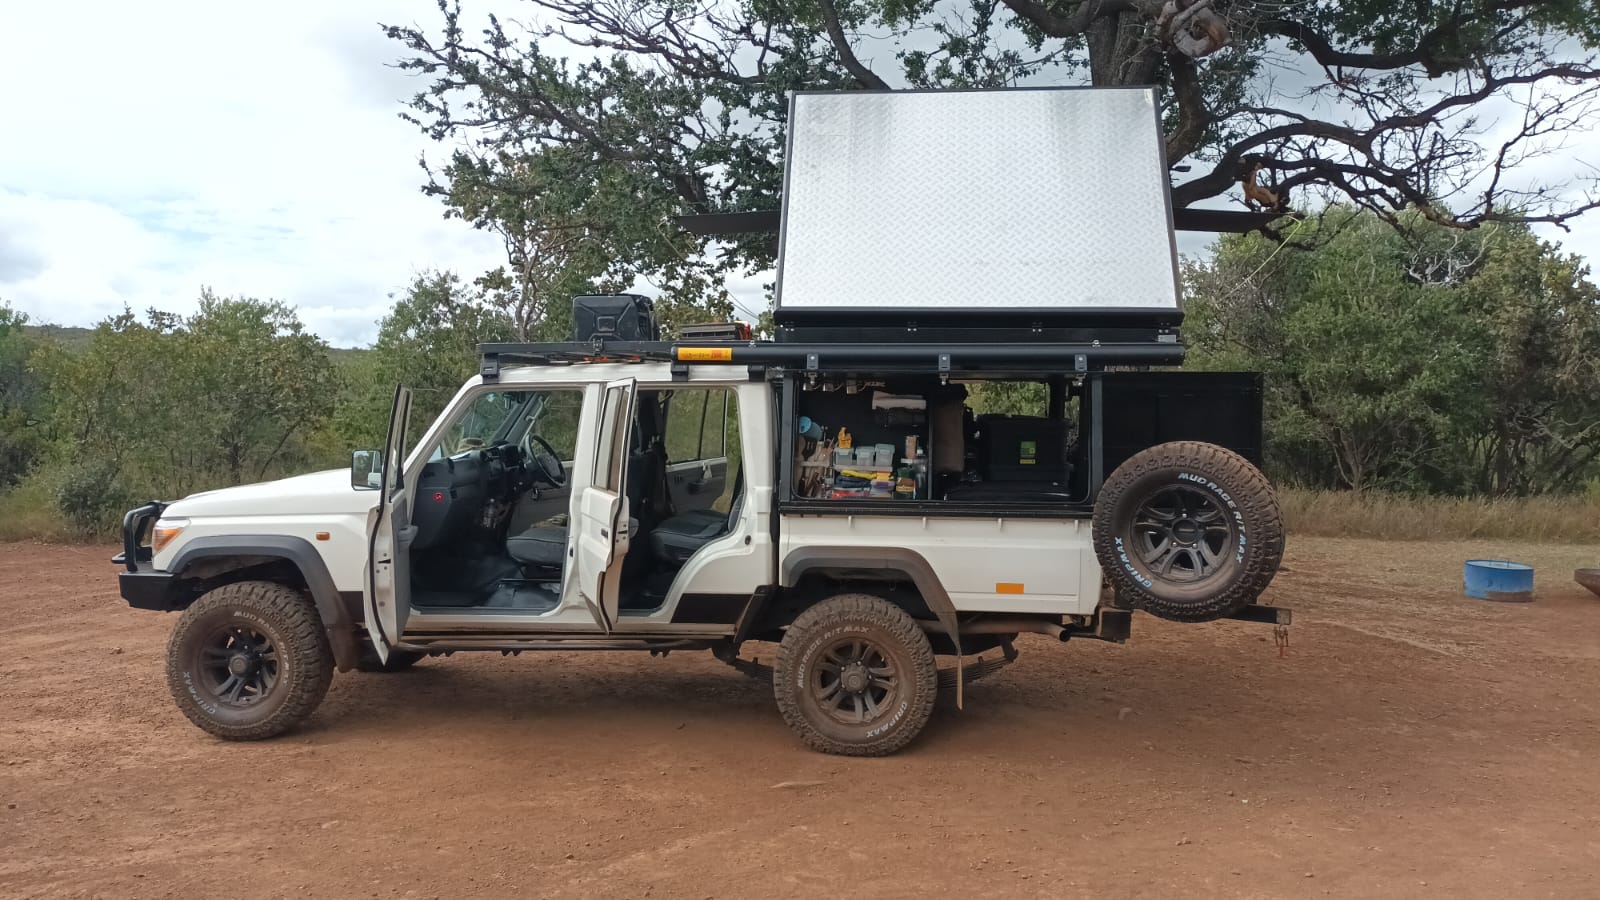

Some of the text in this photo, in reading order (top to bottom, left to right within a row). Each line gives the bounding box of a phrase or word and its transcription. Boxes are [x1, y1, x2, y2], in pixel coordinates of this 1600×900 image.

[1178, 472, 1246, 563] MUD RAGE R/T MAX
[1114, 536, 1152, 588] GRIPMAX
[233, 611, 257, 621] MUD
[183, 671, 216, 714] GRIPMAX
[797, 663, 806, 689] MUD
[866, 701, 908, 738] GRIPMAX
